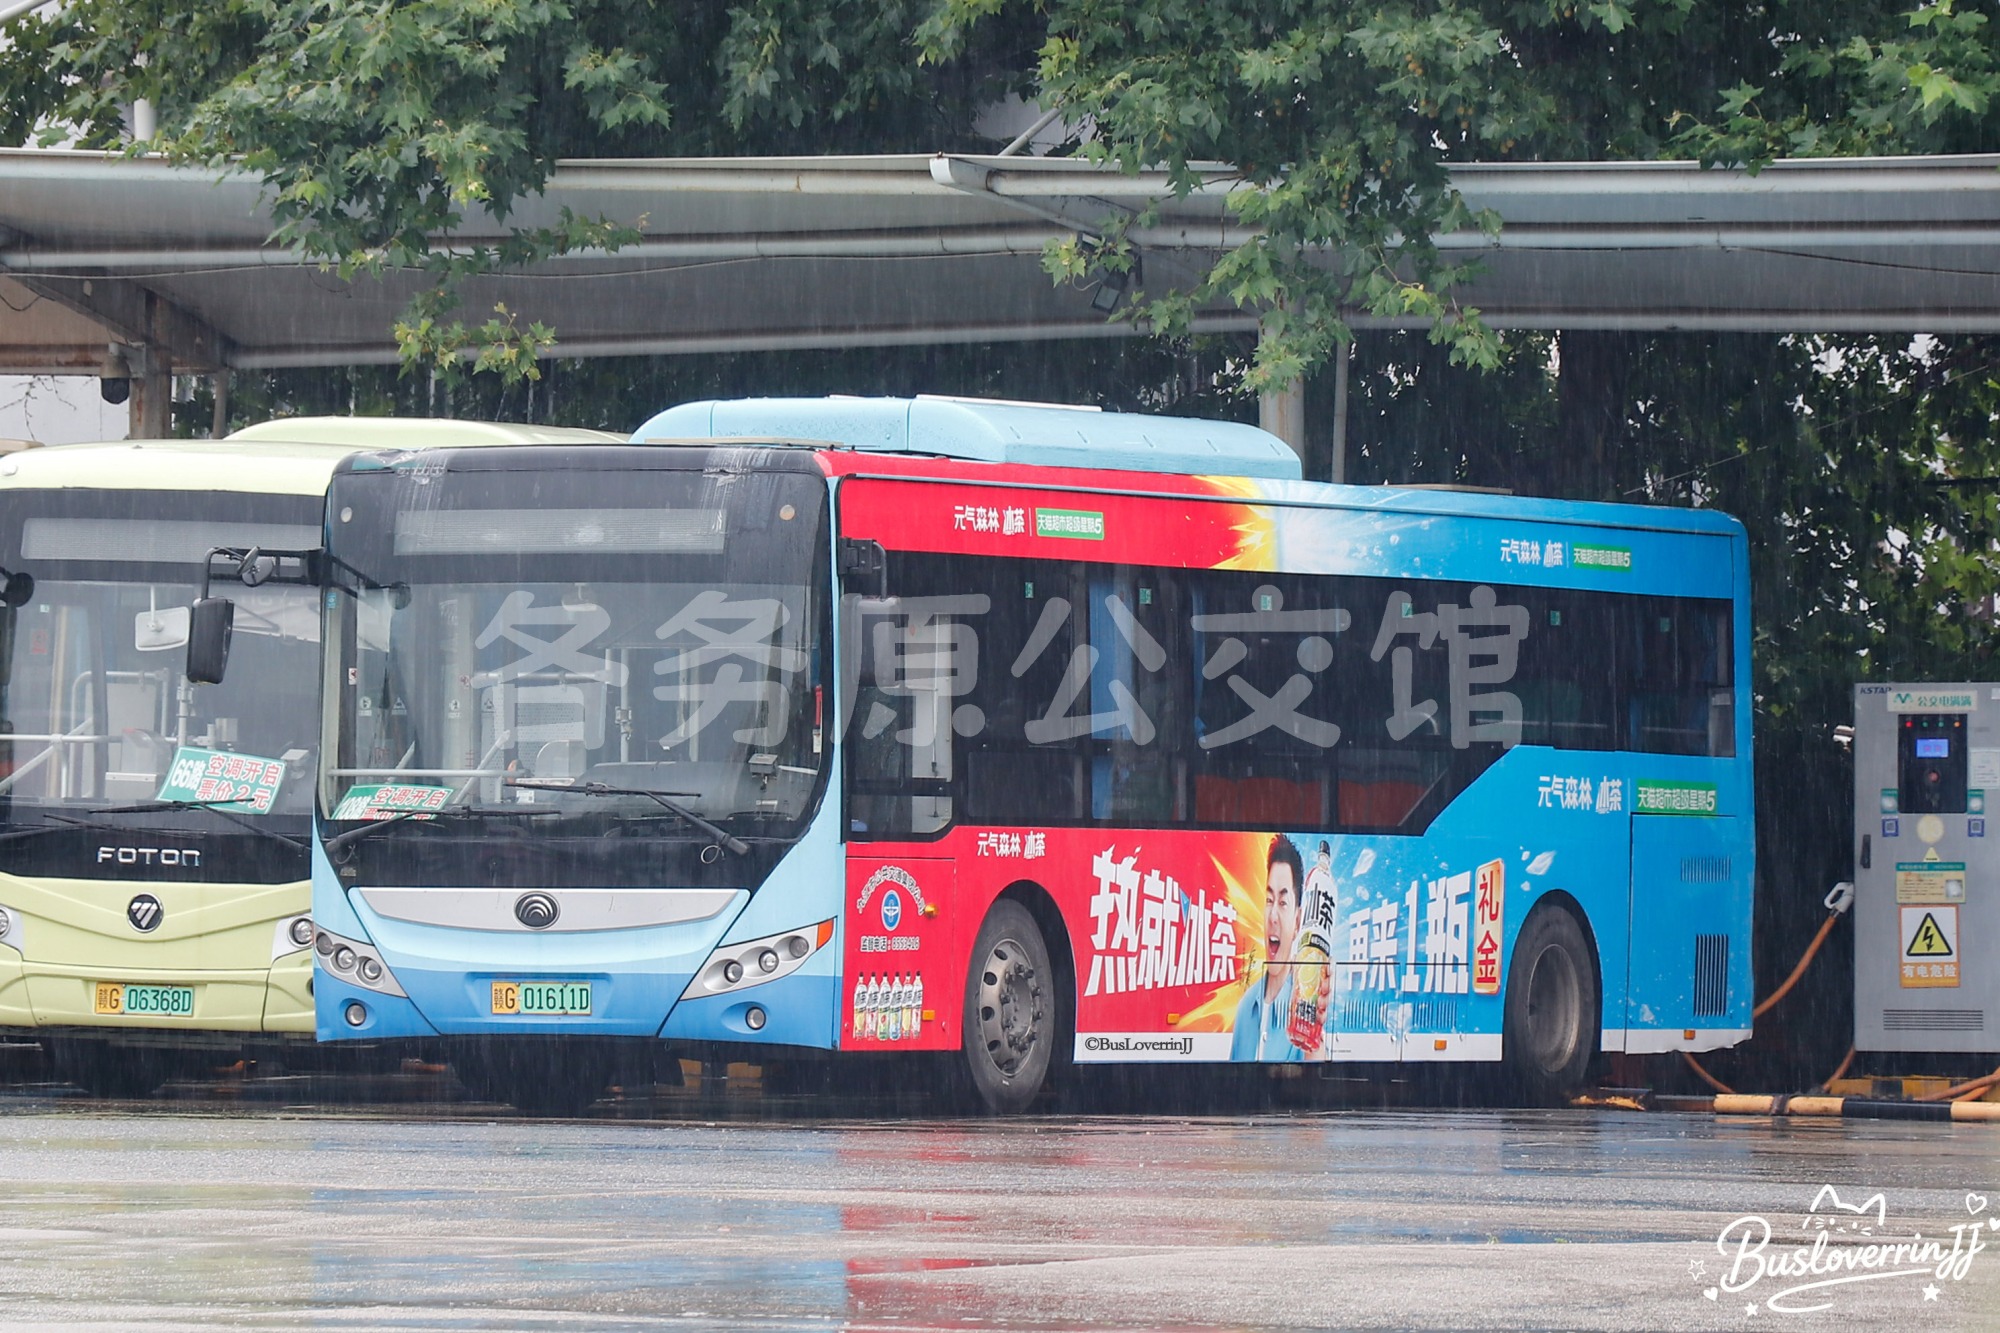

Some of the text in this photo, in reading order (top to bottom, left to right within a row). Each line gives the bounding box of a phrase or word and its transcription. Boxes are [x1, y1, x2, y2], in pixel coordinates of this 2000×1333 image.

[954, 505, 1000, 533] 元气森林
[1500, 539, 1541, 565] 元气森林
[205, 755, 281, 787] 空调开启
[195, 779, 271, 810] 票价2元
[370, 787, 449, 808] 空调开启
[1538, 775, 1592, 811] 元气森林
[97, 846, 200, 866] FOTON
[977, 831, 1021, 857] 元气森林
[1084, 844, 1237, 996] 热就冰茶
[1348, 870, 1471, 994] 再来1瓶
[1476, 870, 1500, 984] 礼金
[1902, 964, 1957, 978] 有电危险
[494, 987, 589, 1010] 赣G01611D
